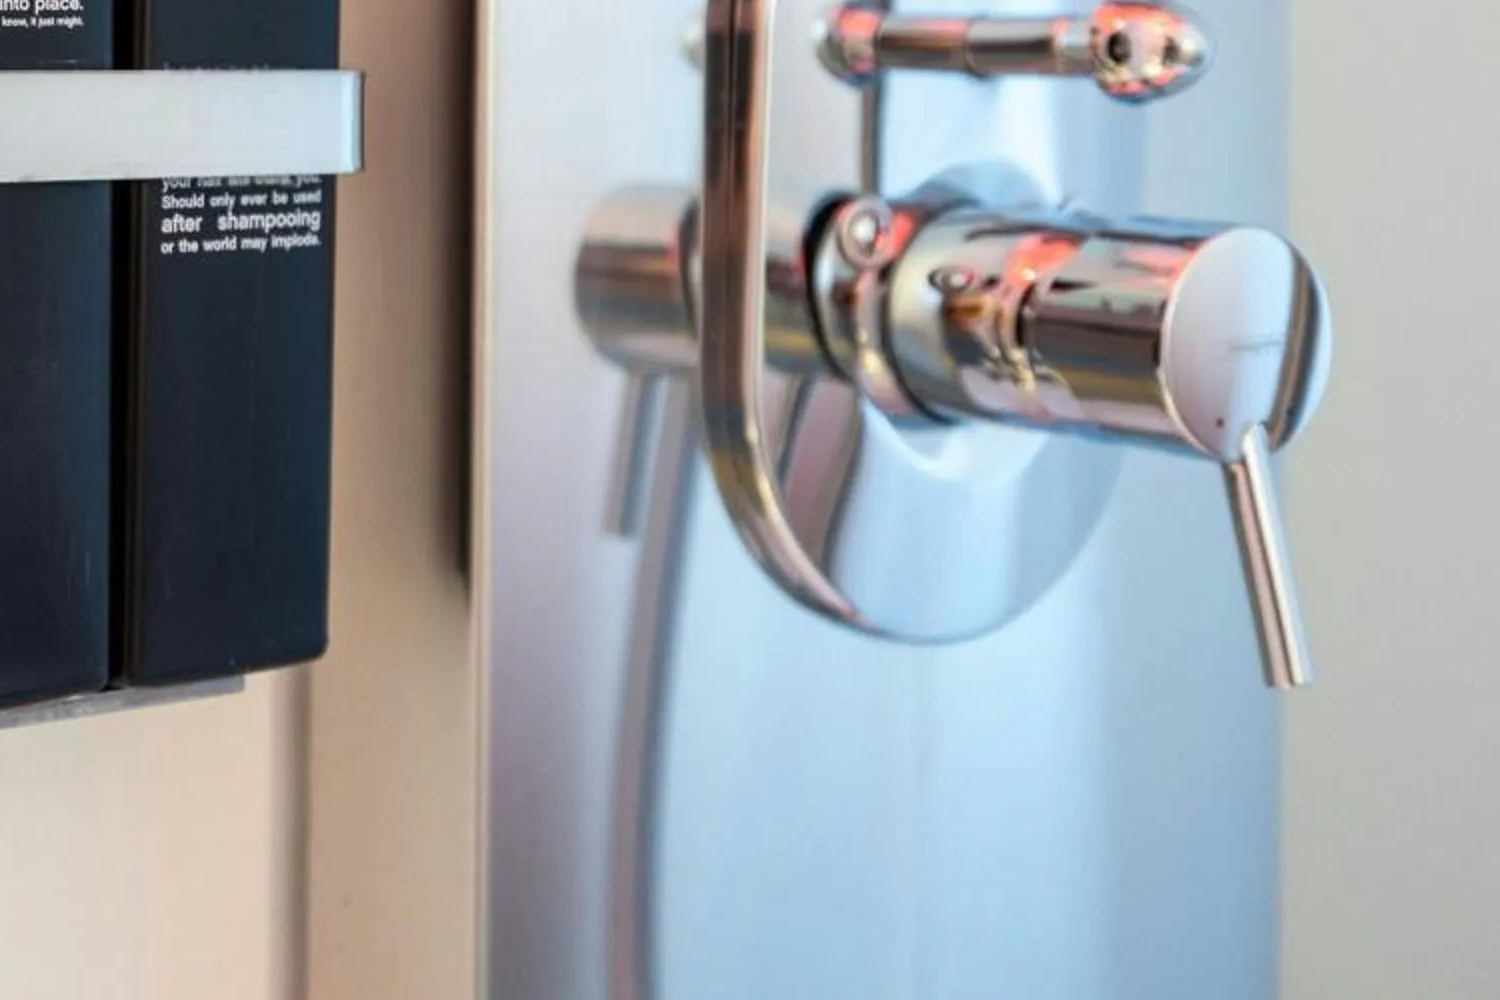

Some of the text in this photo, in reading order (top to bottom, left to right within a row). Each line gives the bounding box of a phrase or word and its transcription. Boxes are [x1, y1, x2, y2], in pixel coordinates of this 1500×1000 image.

[161, 193, 205, 210] Should
[209, 192, 236, 211] only
[240, 194, 268, 206] ever
[272, 190, 288, 205] be
[161, 208, 321, 234] after shampooing
[160, 241, 174, 254] or
[178, 238, 199, 253] the
[203, 236, 237, 251] world
[240, 238, 268, 254] may
